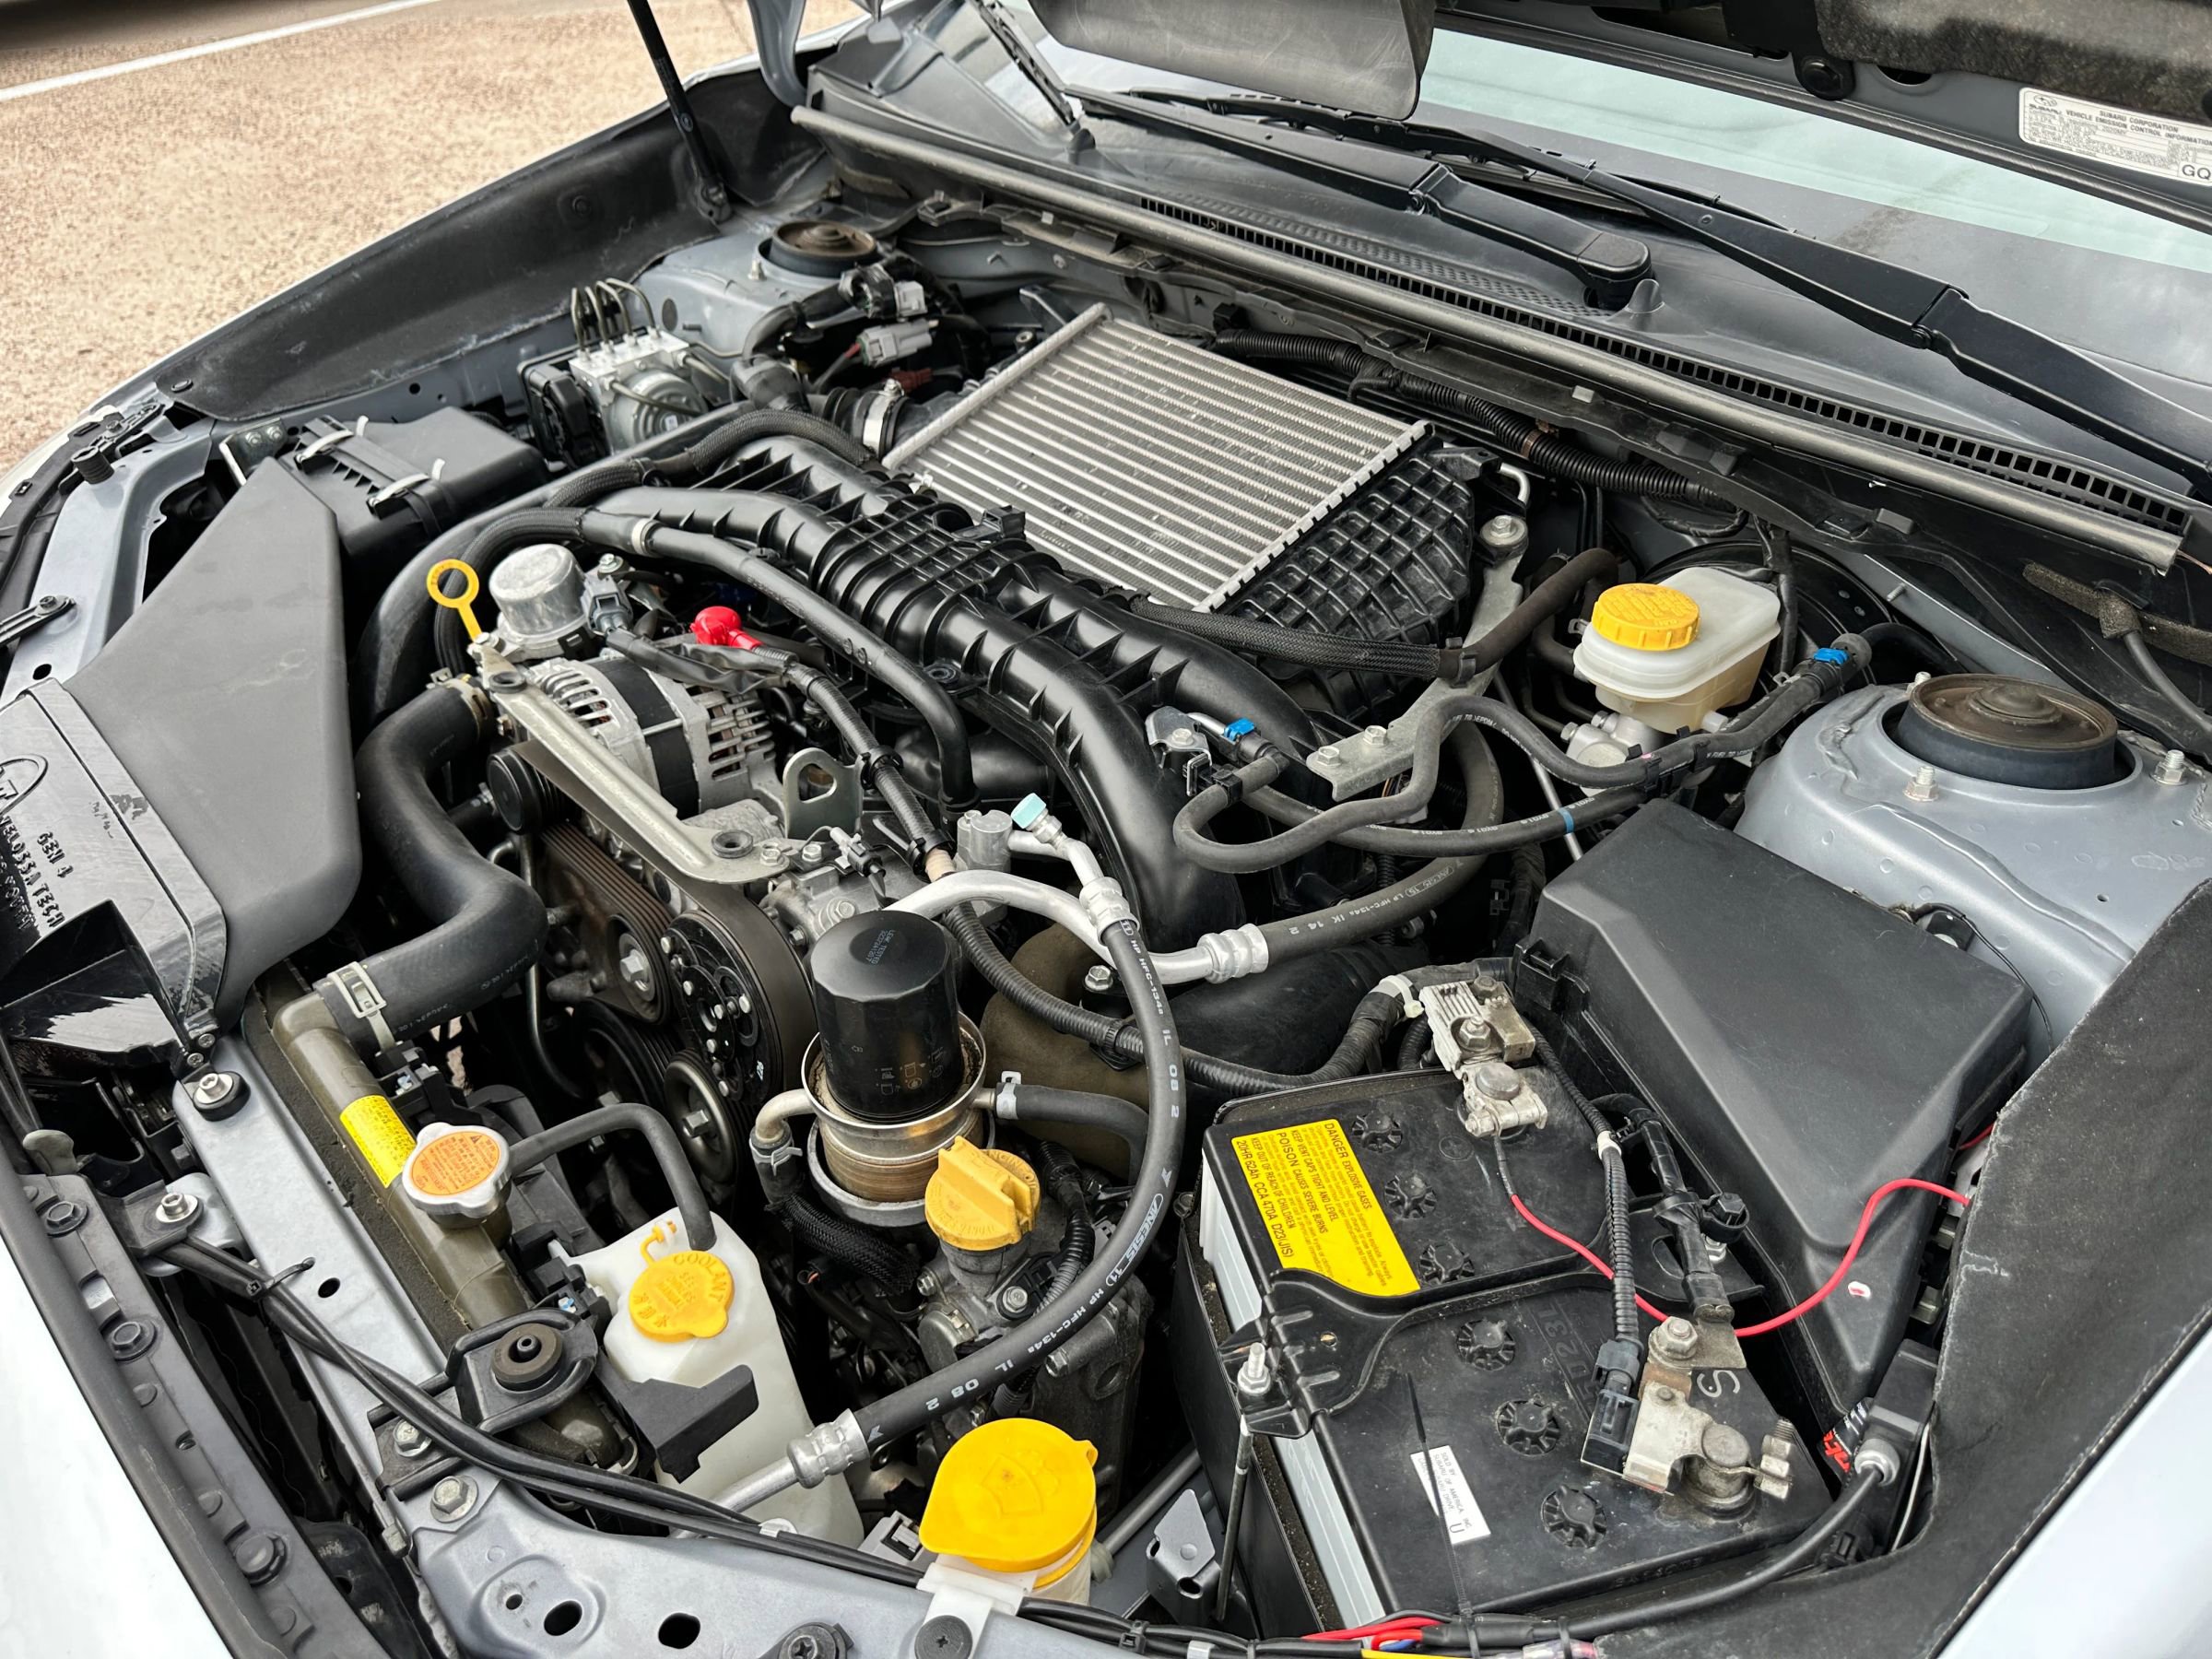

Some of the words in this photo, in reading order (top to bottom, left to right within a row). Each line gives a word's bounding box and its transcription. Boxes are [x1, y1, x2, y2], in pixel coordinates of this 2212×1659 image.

[2065, 110, 2092, 120] VEHICLE
[2095, 116, 2126, 128] EMISSION
[2130, 124, 2161, 136] CONTROL
[2099, 111, 2126, 121] SUBARU
[2129, 116, 2178, 133] CORPORATION
[37, 831, 65, 865] GEN
[32, 882, 66, 928] TECH
[1347, 897, 1391, 917] HFC-134a
[1331, 912, 1345, 924] IK
[1288, 925, 1300, 935] 2
[1130, 938, 1140, 955] HP
[1138, 956, 1164, 1017] HFC-134a
[1160, 1028, 1173, 1046] IL
[1169, 1064, 1178, 1090] 08
[1171, 1104, 1179, 1118] 2
[1249, 1136, 1263, 1151] KEEP
[1289, 1129, 1303, 1143] KEEP
[1235, 1139, 1253, 1159] 20HR
[1255, 1150, 1268, 1163] OUT
[1296, 1143, 1310, 1157] VENT
[988, 1149, 1029, 1173] NGINE
[1244, 1159, 1262, 1179] 62Ah
[1261, 1162, 1272, 1171] OF
[1302, 1158, 1317, 1172] CAPS
[1323, 1122, 1348, 1159] DANGER
[1341, 1159, 1362, 1189] EXPLOSIVE
[1356, 1190, 1372, 1209] GASES
[1253, 1181, 1270, 1199] CCA
[1264, 1171, 1280, 1190] REACH
[1275, 1131, 1300, 1167] POISON
[1291, 1168, 1309, 1190] CAUSES
[1301, 1190, 1319, 1212] SEVERE
[1312, 1213, 1328, 1234] BURNS
[1310, 1173, 1324, 1189] TIGHT
[1317, 1190, 1330, 1203] AND
[1260, 1199, 1279, 1219] 470A
[1276, 1197, 1298, 1229] CHILDREN
[1324, 1203, 1339, 1221] LEVEL
[1270, 1222, 1295, 1257] D23(JIS)
[672, 1252, 727, 1303] COOLANT
[1108, 1265, 1124, 1283] 11
[1085, 1287, 1106, 1305] HP
[1027, 1304, 1088, 1356] HFC-134a
[994, 1358, 1014, 1375] IL
[948, 1377, 981, 1399] 08
[924, 1396, 940, 1411] 2
[1449, 1487, 1465, 1513] AMERICA
